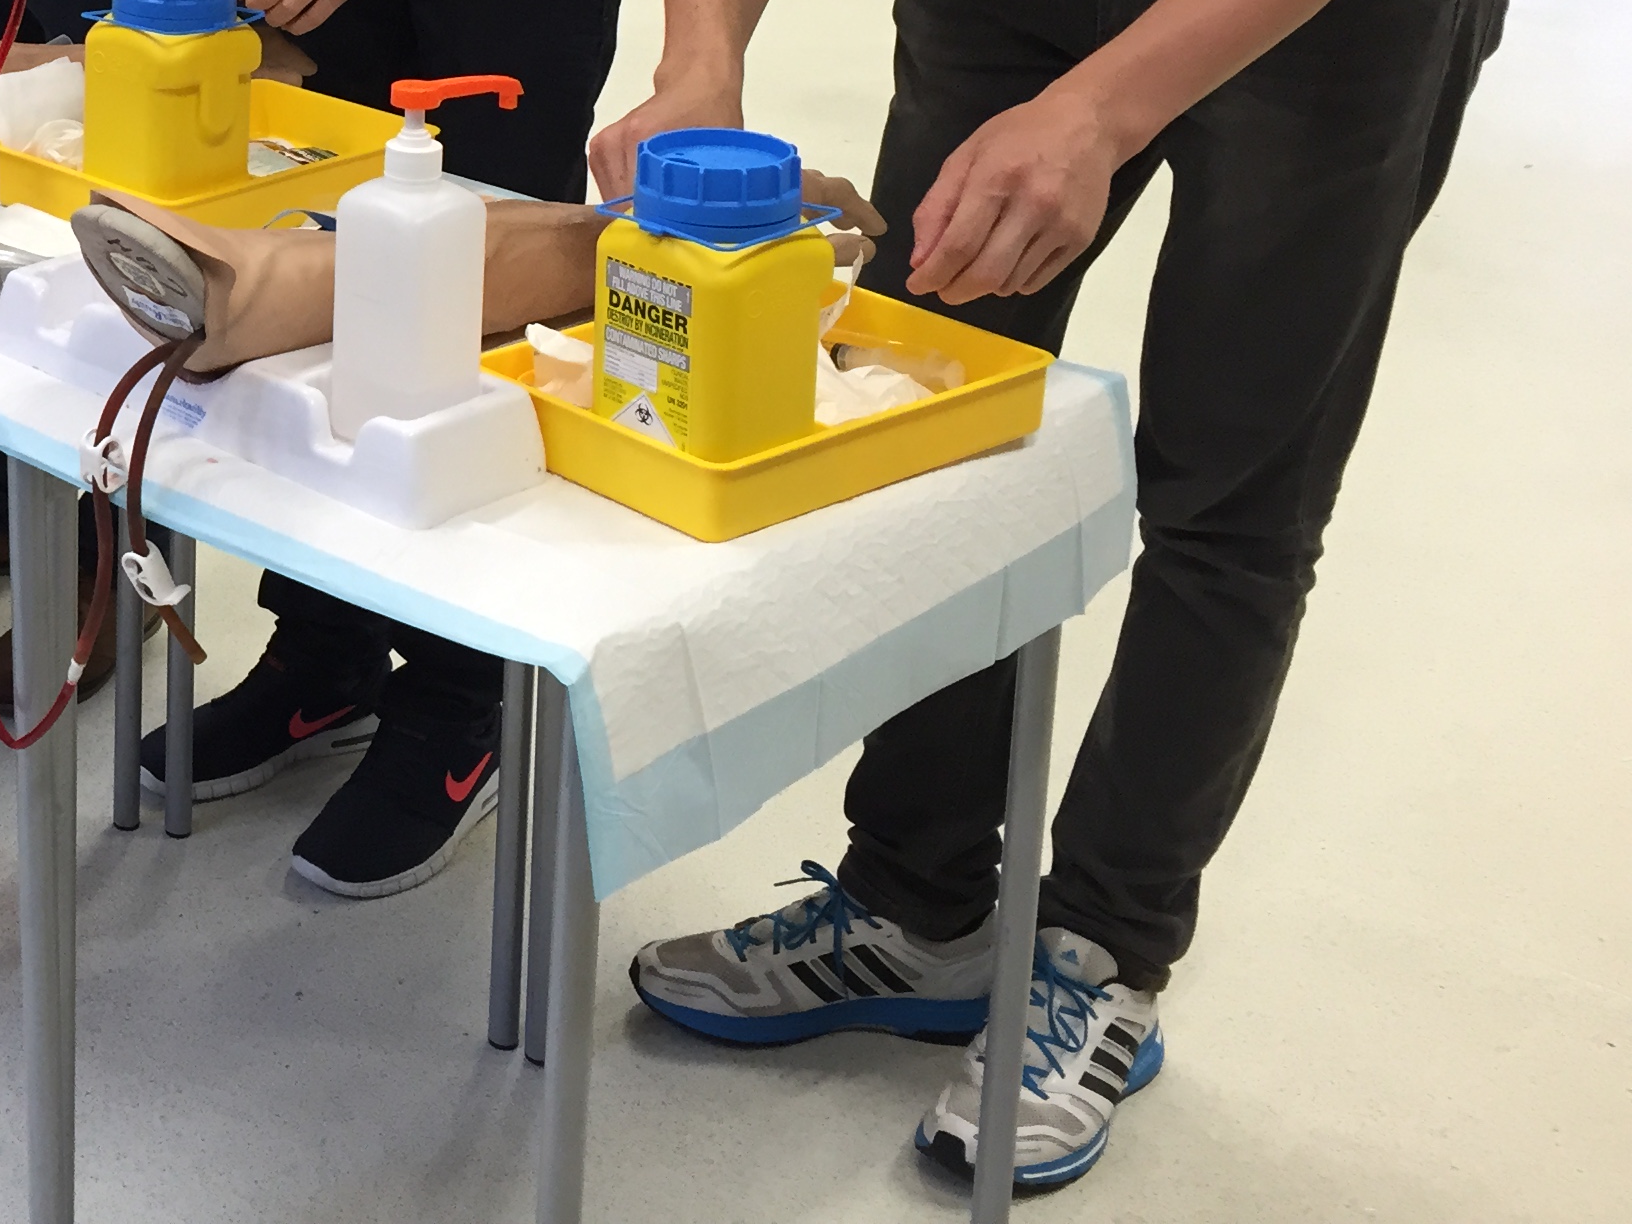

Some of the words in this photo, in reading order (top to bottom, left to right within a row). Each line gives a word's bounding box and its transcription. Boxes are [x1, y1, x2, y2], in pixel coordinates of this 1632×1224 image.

[611, 276, 626, 292] FILL
[627, 281, 648, 301] ABOVE
[649, 289, 666, 307] THIS
[666, 294, 683, 313] LINE
[618, 265, 650, 288] WARNING
[652, 278, 662, 292] DO
[663, 281, 678, 297] NOT
[607, 306, 634, 328] DESTROY
[634, 317, 644, 331] BY
[644, 321, 689, 350] INCINERATION
[609, 288, 688, 335] DANGER
[605, 326, 657, 358] CONTAMINATED
[658, 347, 687, 370] SHARPS
